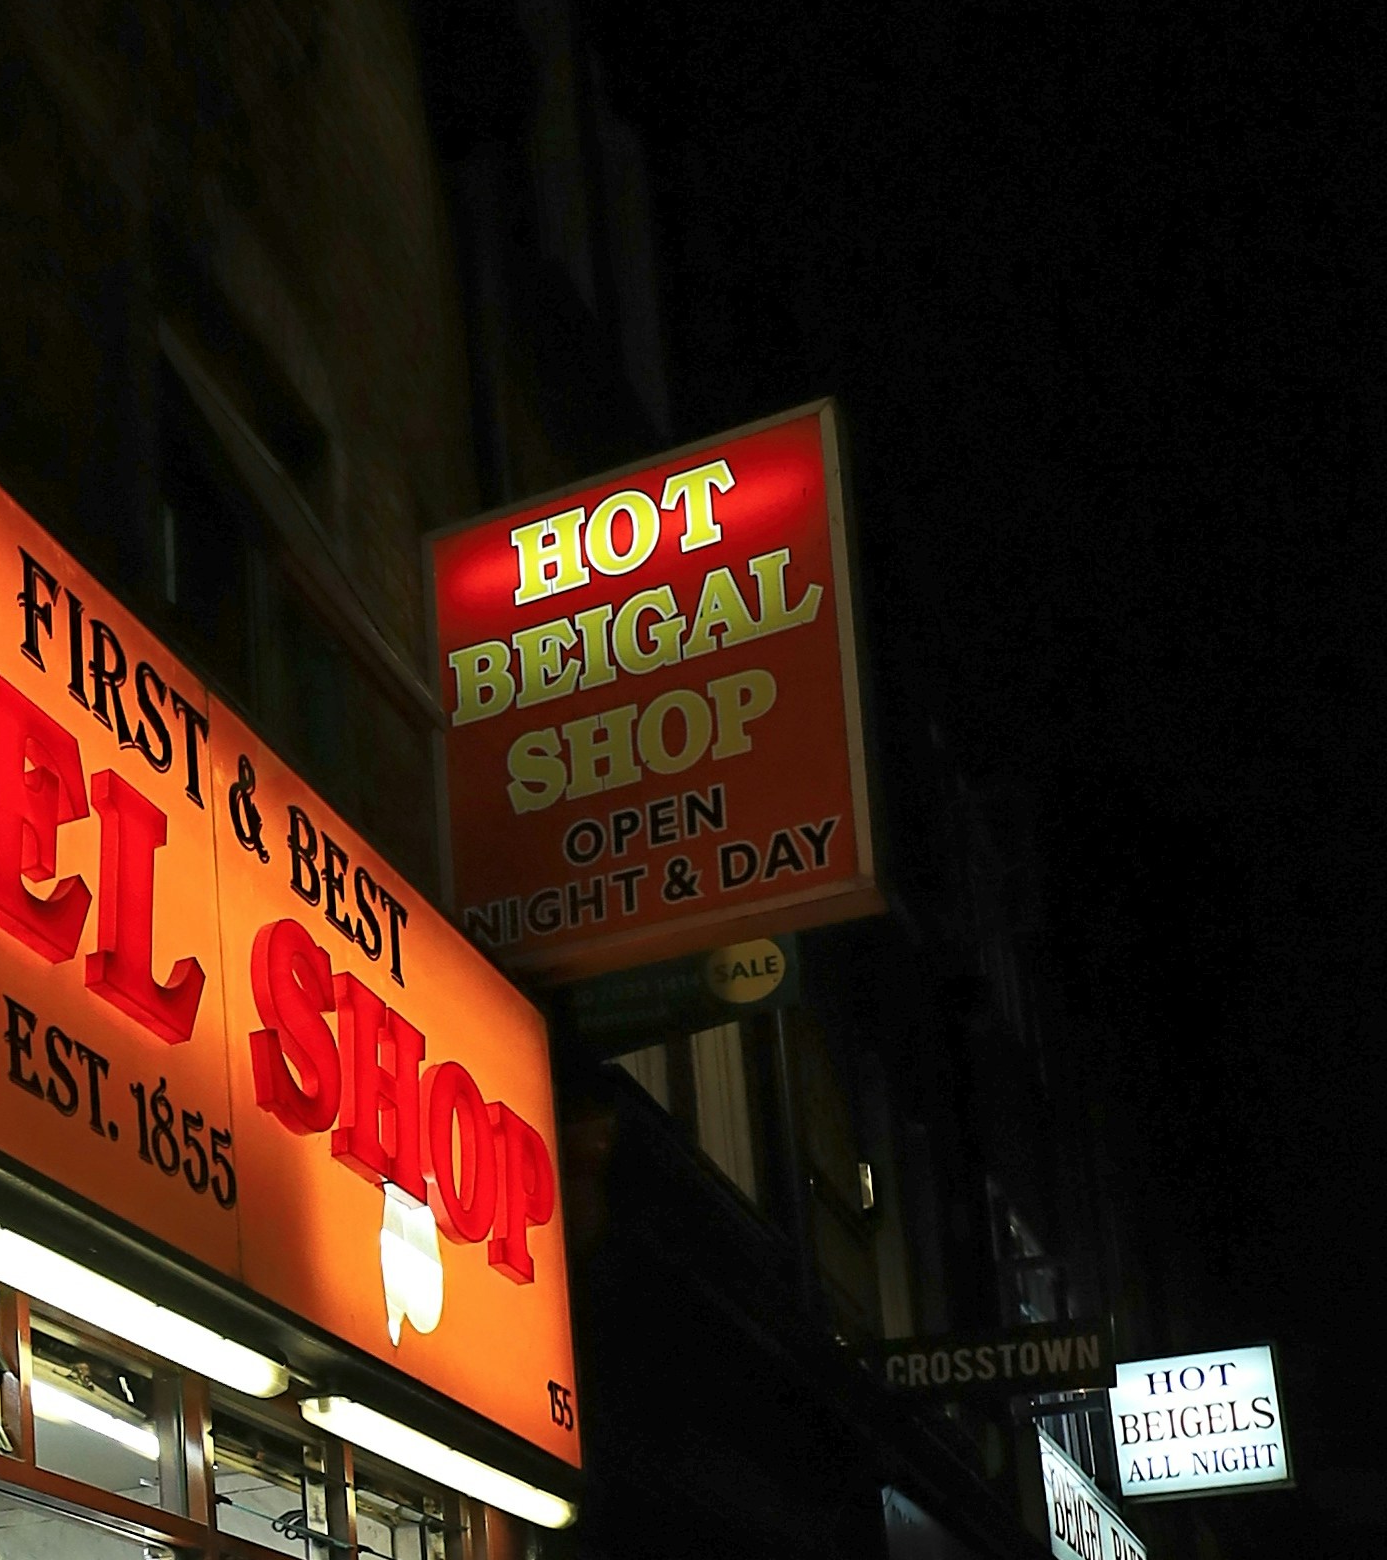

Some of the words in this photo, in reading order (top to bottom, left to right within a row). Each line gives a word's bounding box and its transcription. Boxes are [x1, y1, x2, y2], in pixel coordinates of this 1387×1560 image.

[510, 458, 736, 607] HOT
[447, 548, 824, 728] BEIGAL
[16, 546, 210, 810] FIRST
[229, 753, 269, 865] &
[288, 804, 408, 987] BEST
[506, 668, 778, 816] SHOP
[463, 864, 649, 948] NIGHT
[661, 854, 704, 906] &
[718, 813, 844, 897] DAY
[562, 782, 726, 869] OPEN
[715, 954, 781, 983] SALE
[3, 996, 119, 1142] EST.
[131, 1077, 238, 1210] 1855
[249, 918, 554, 1284] SHOP
[546, 1377, 574, 1433] 155
[885, 1336, 1100, 1386] CROSSTOWN
[1146, 1362, 1237, 1396] HOT
[1118, 1397, 1276, 1446] BEIGELS
[1127, 1454, 1181, 1483] ALL
[1192, 1443, 1279, 1476] NIGHT
